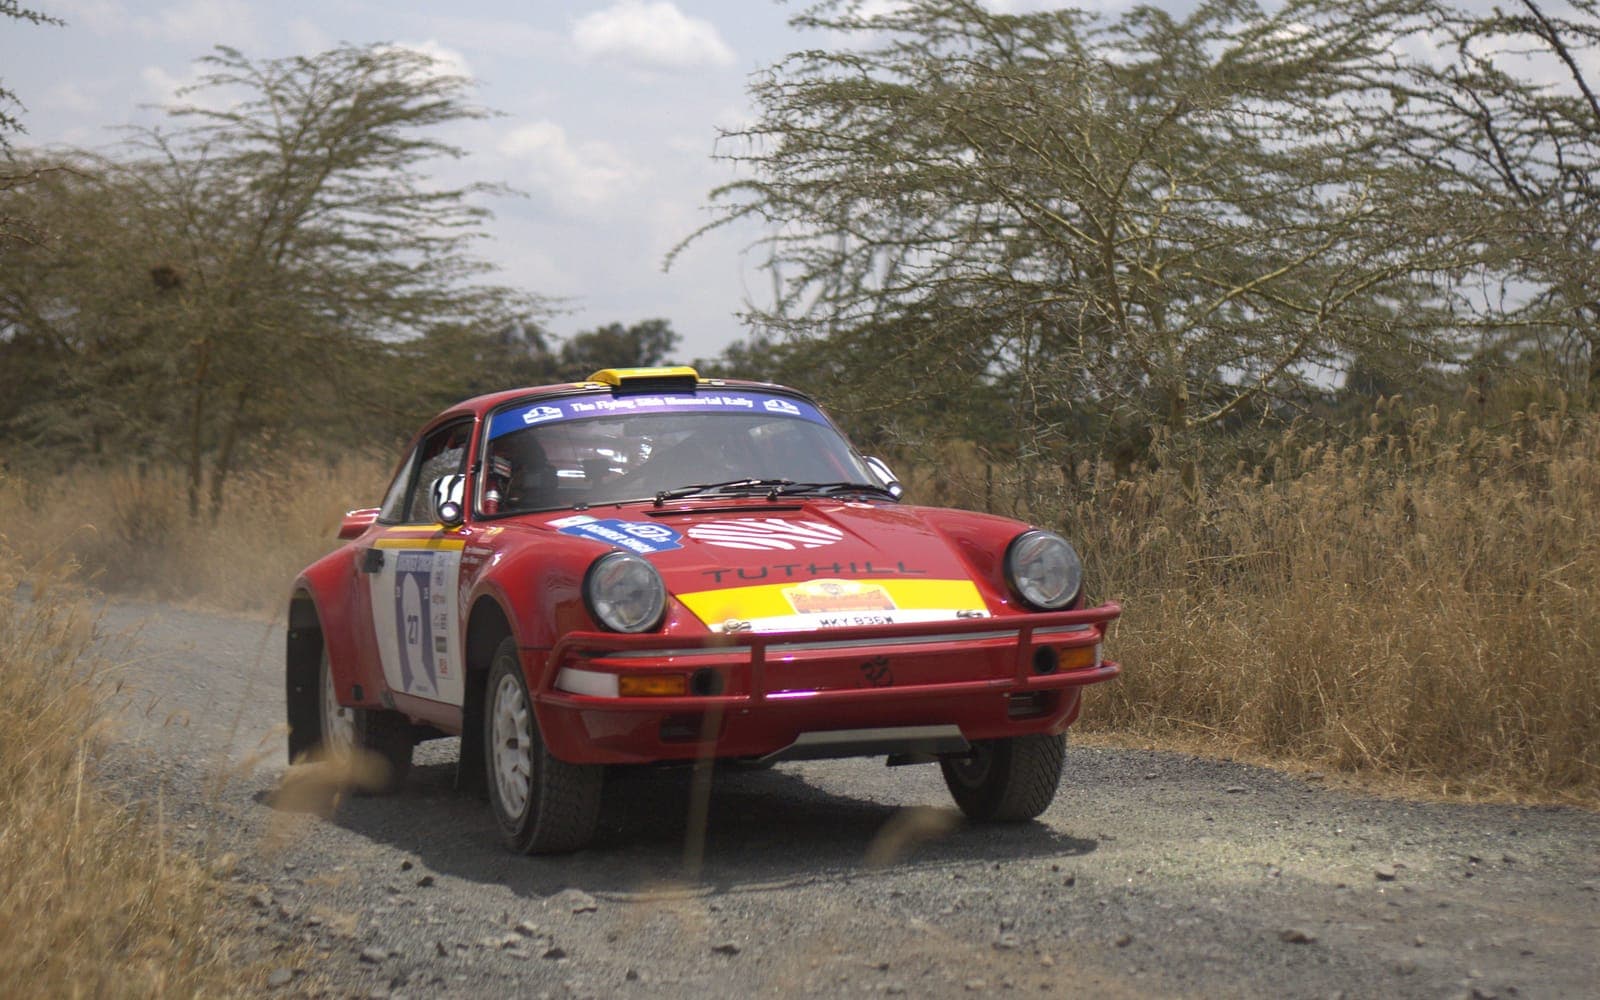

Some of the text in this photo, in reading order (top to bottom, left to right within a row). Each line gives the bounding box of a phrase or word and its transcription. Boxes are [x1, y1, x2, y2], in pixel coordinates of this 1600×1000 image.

[571, 402, 596, 412] The
[596, 399, 636, 411] Flying
[664, 396, 723, 406] Memorial
[722, 397, 753, 408] Rally
[703, 562, 926, 583] TUTHILL
[407, 614, 418, 645] 27
